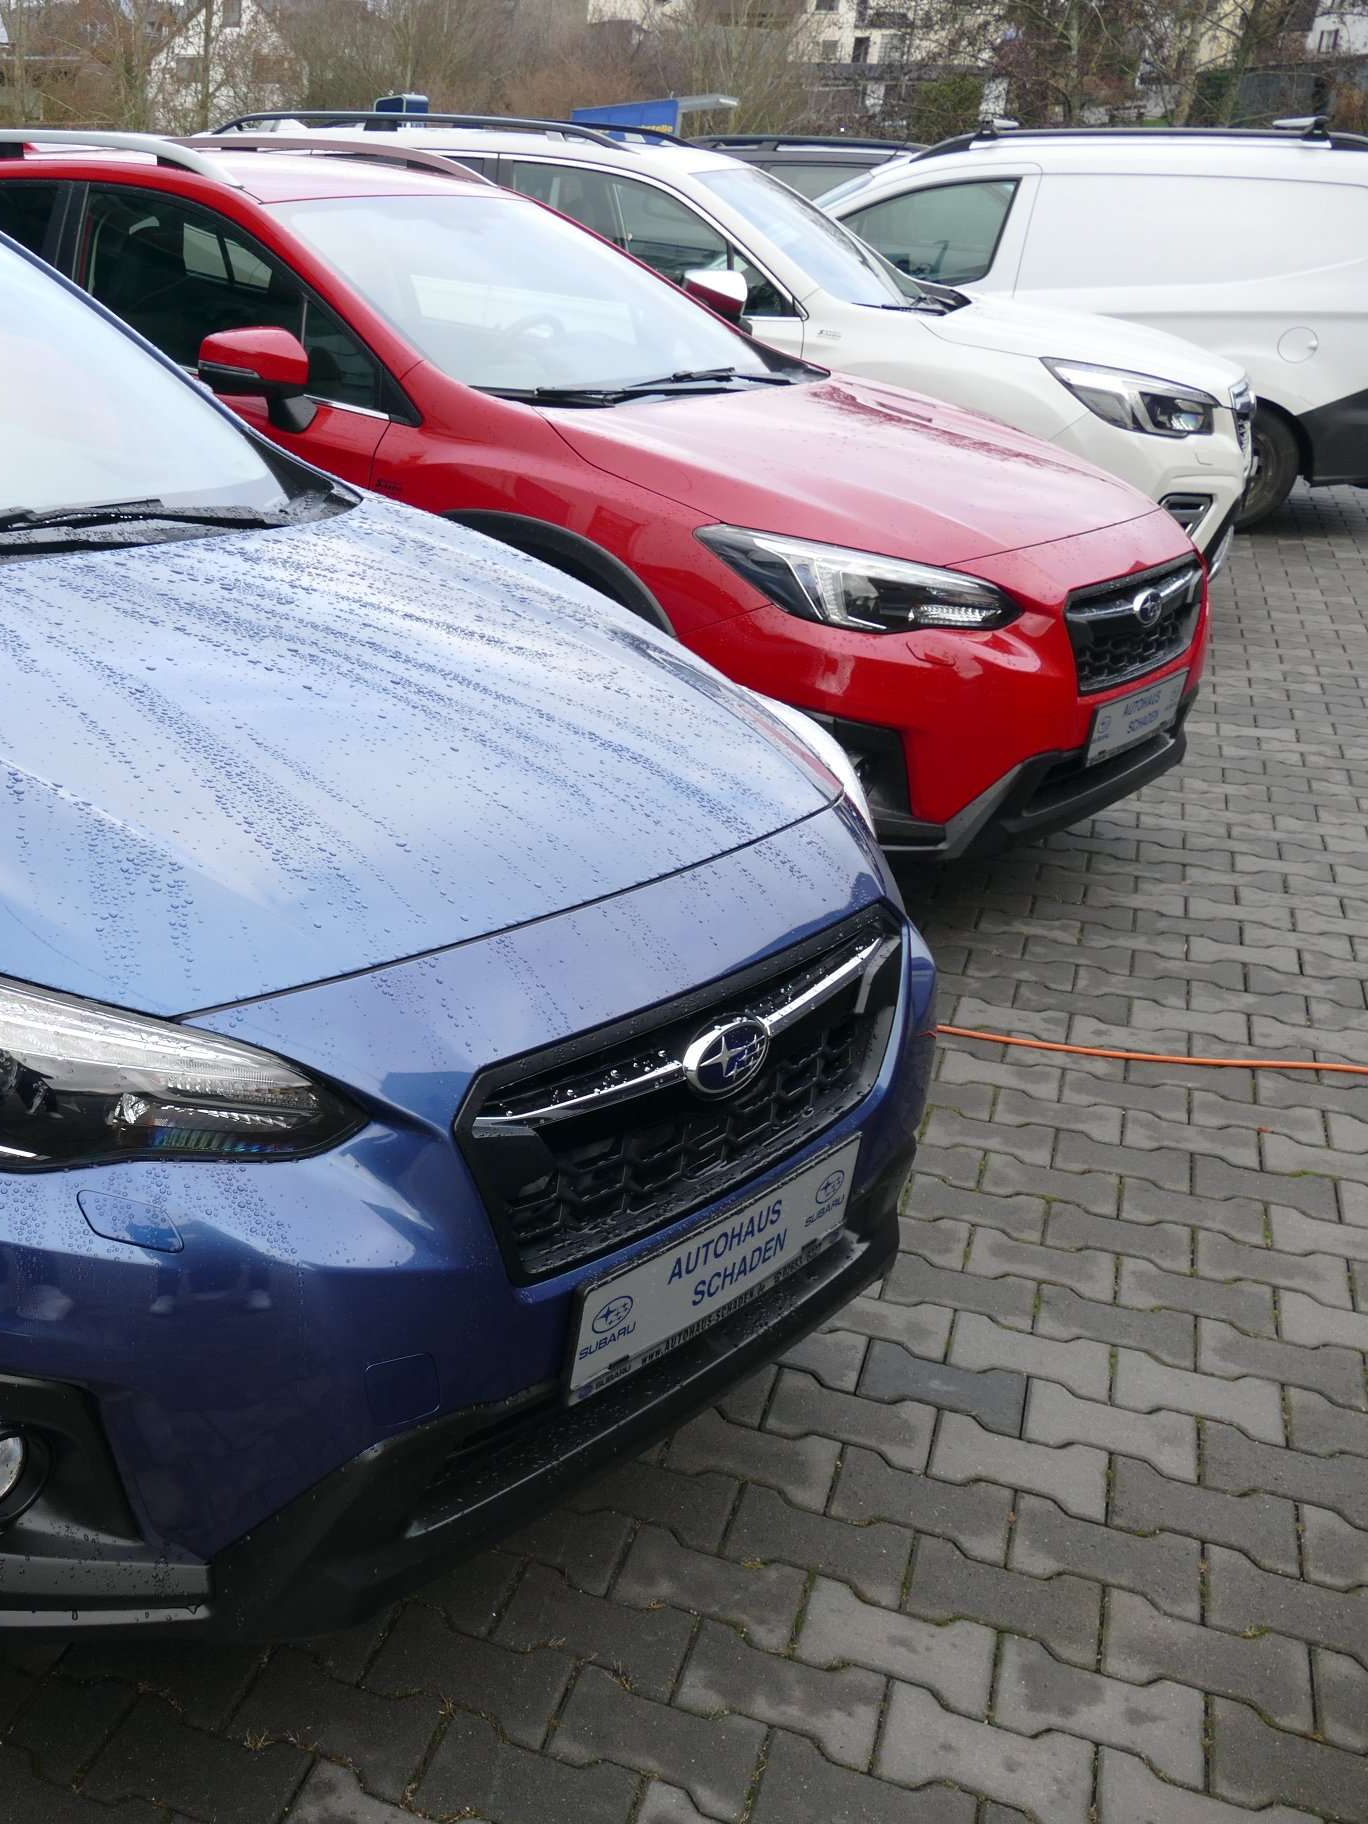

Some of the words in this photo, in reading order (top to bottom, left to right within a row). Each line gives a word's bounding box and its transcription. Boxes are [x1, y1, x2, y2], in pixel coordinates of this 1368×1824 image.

[804, 1193, 845, 1228] SUBARU
[667, 1199, 783, 1285] AUTOHAUS
[692, 1228, 788, 1307] SCHADEN
[577, 1320, 637, 1360] SUBARU
